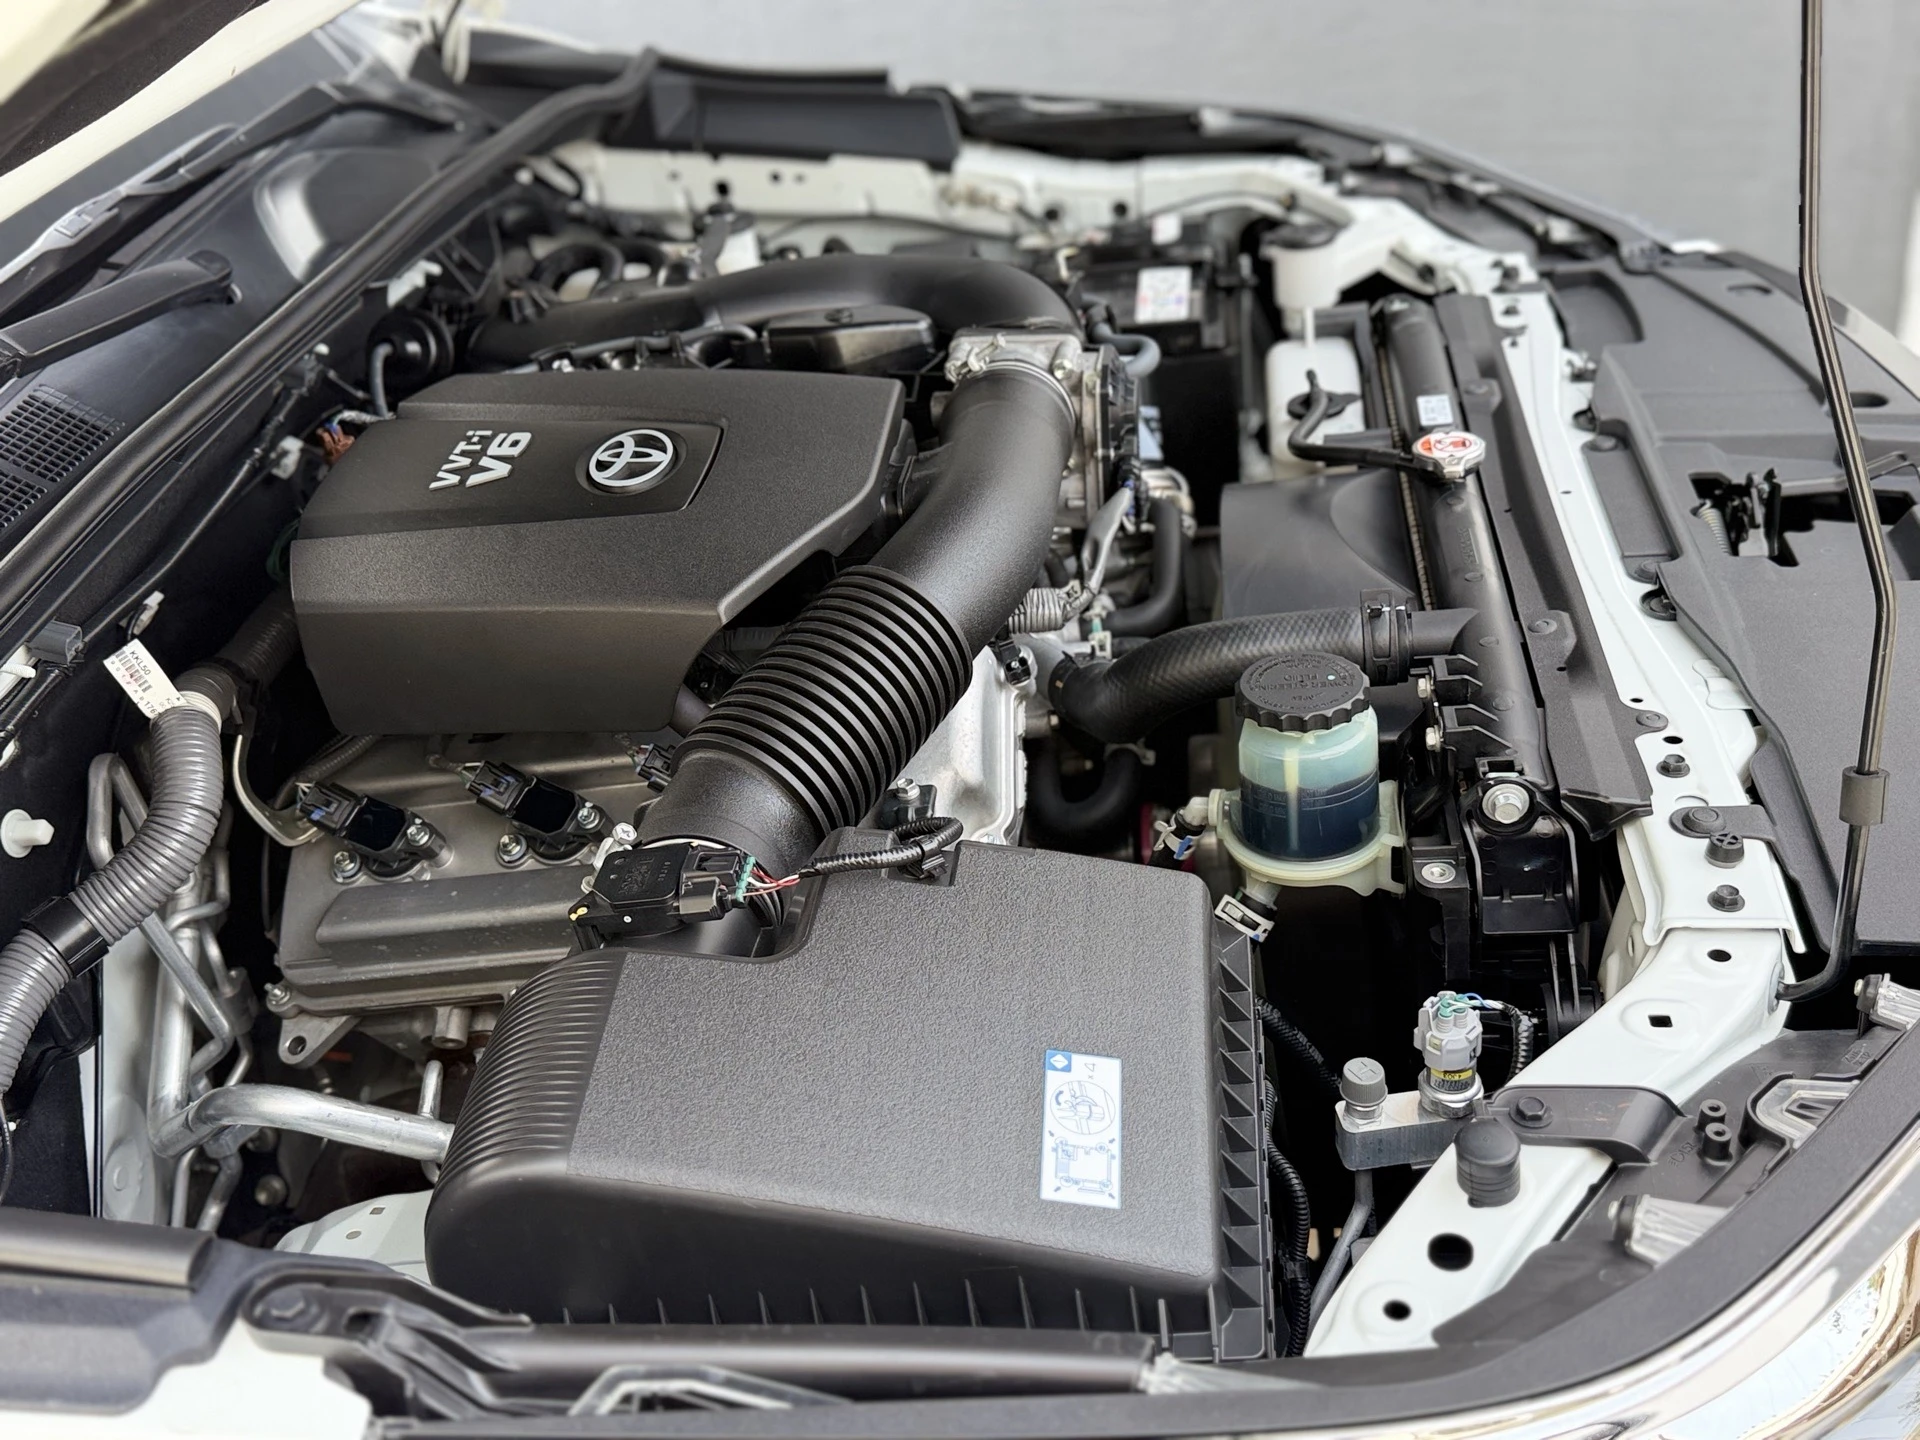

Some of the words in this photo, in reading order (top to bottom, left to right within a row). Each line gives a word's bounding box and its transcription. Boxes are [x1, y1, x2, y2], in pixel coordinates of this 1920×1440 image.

[429, 430, 493, 490] VVT-i
[465, 431, 532, 488] V6
[129, 650, 151, 676] KKL50
